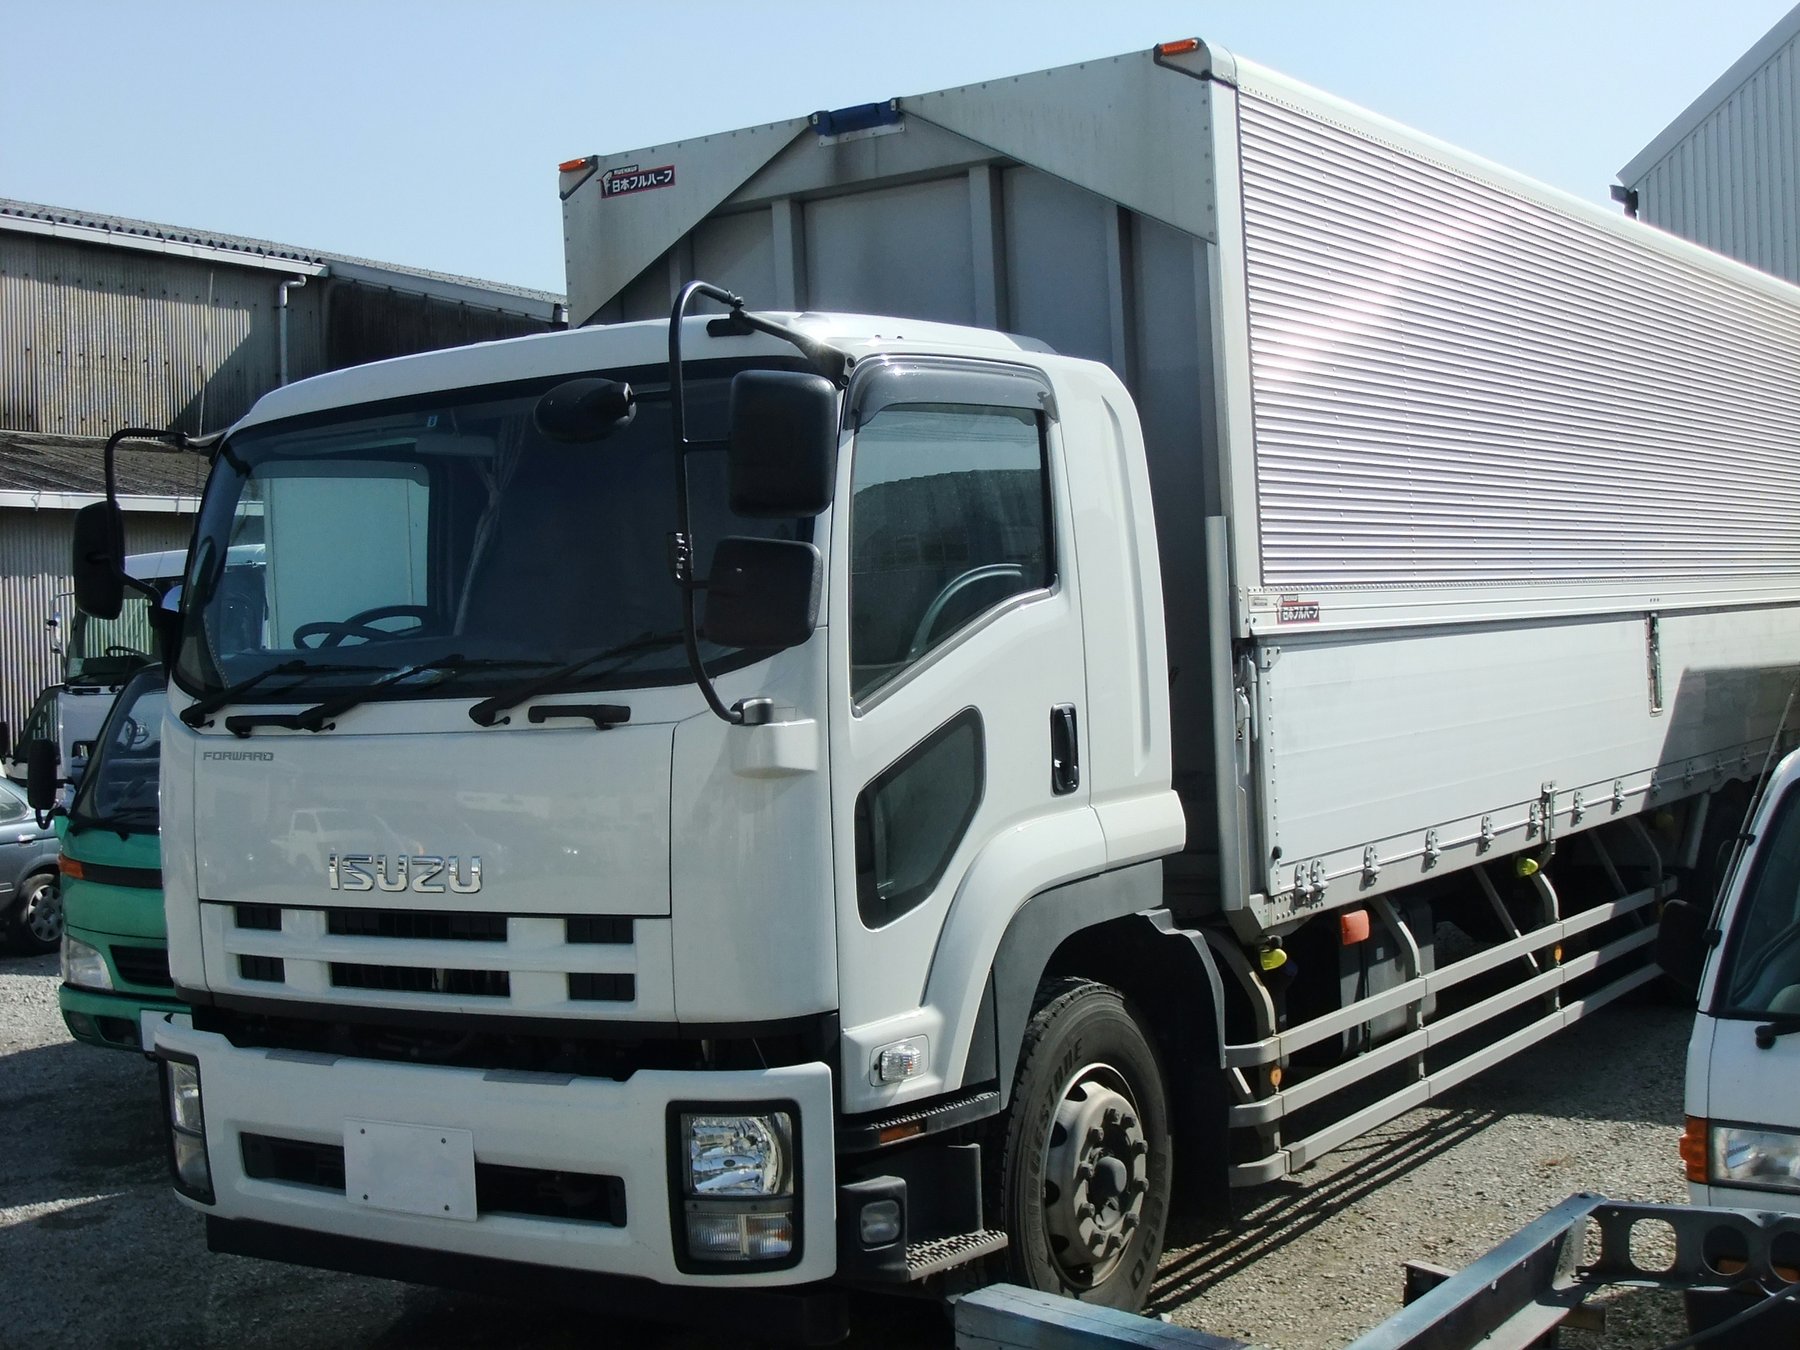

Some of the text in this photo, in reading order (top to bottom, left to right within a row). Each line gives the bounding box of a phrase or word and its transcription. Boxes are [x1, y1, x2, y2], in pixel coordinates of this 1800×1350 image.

[612, 170, 673, 193] 日本フルハーフ
[203, 751, 274, 761] FORWARD
[328, 853, 482, 894] ISUZU
